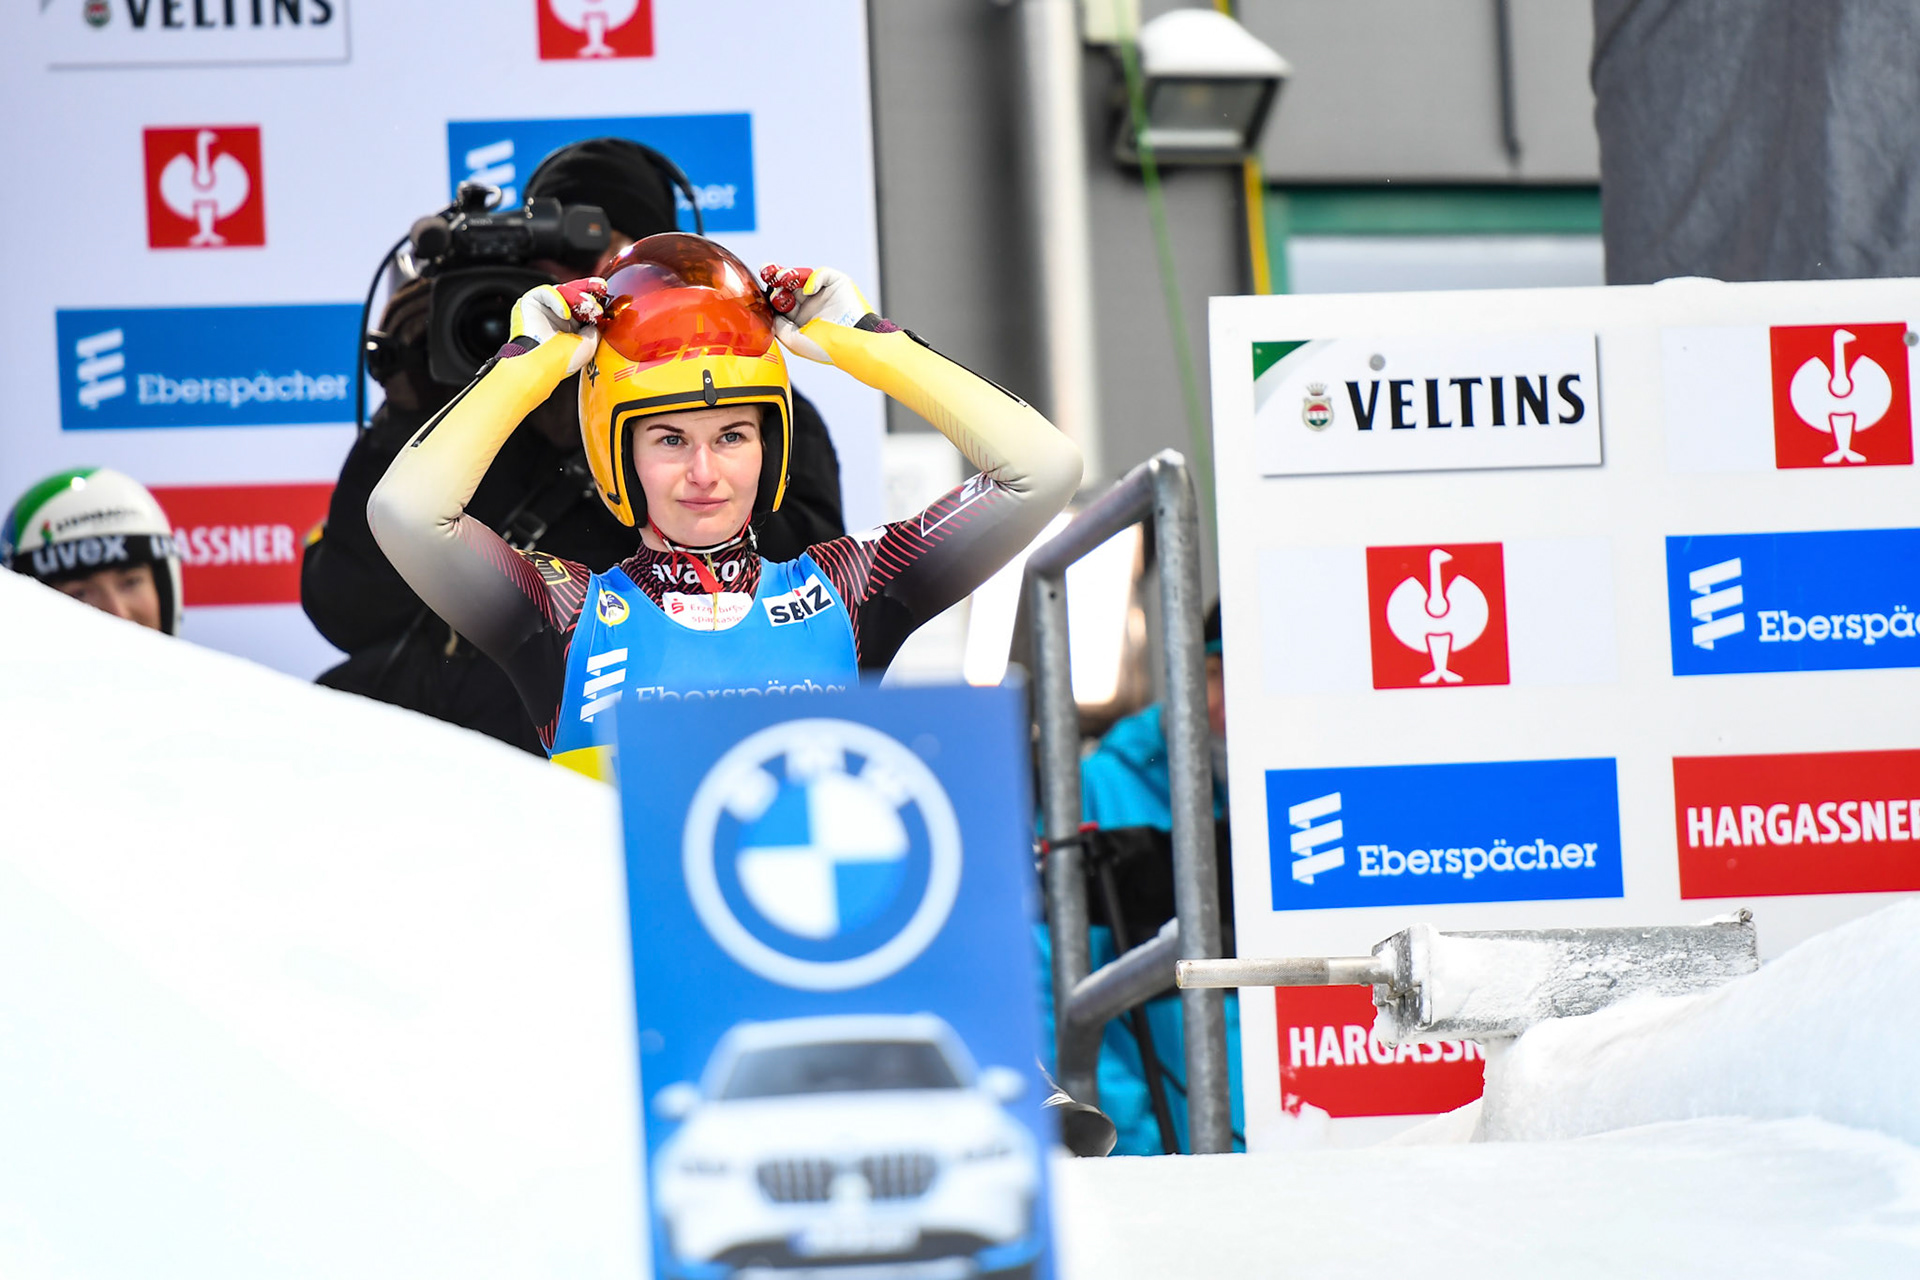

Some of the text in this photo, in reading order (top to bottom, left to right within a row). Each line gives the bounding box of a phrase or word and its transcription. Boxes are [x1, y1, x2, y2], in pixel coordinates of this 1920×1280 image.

[126, 0, 334, 28] VELTINS
[635, 331, 767, 374] DHL
[136, 370, 350, 408] Eberspächer
[1345, 373, 1586, 431] VELTINS
[32, 534, 128, 574] uvex
[173, 524, 296, 566] ASSNER
[652, 557, 747, 585] avao
[690, 604, 746, 615] Erzgbirgs-
[770, 584, 832, 624] SEIZ
[1757, 605, 1920, 646] Eberspä
[1357, 839, 1598, 879] Eberspächer
[1289, 1025, 1486, 1067] HARGASS
